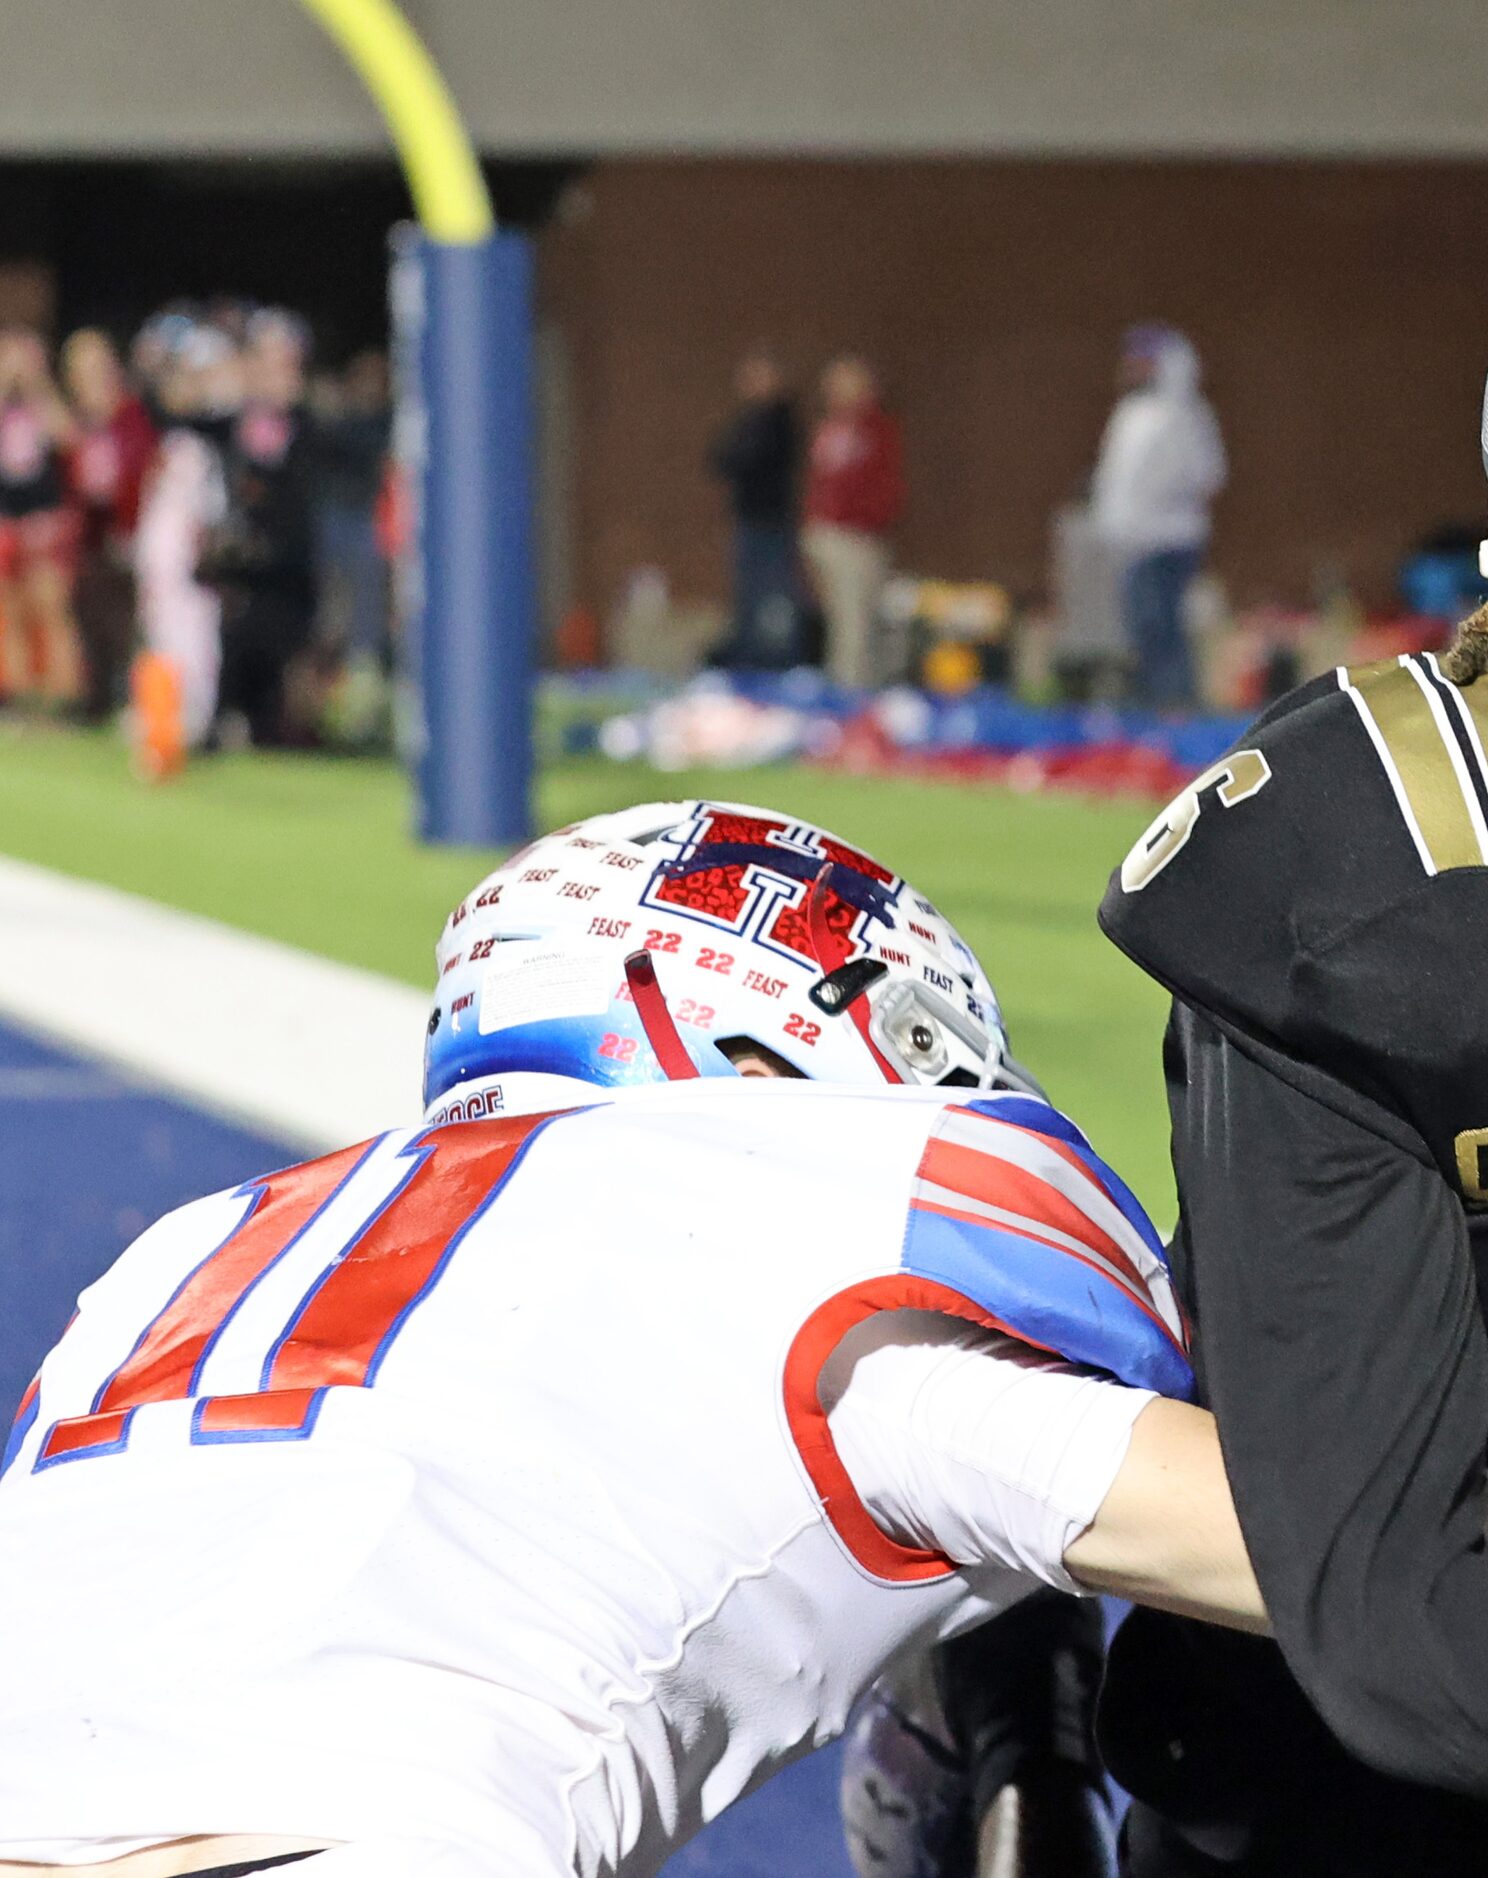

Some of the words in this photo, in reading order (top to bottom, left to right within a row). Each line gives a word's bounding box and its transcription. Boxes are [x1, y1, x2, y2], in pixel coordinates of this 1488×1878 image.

[1121, 749, 1272, 893] 6
[600, 851, 644, 872] FEAST
[518, 869, 559, 884] FEAST
[556, 882, 602, 901] FEAST
[587, 917, 632, 939] FEAST
[908, 920, 937, 945] HUNT
[469, 938, 496, 962] 22
[643, 929, 683, 953] 22
[695, 947, 736, 975] 22
[879, 945, 911, 967] HUNT
[742, 969, 789, 999] FEAST
[923, 965, 953, 994] FEAST
[451, 991, 476, 1014] HUNT
[675, 998, 716, 1029] 22
[782, 1012, 821, 1047] 22
[597, 1032, 638, 1063] 22
[31, 1102, 616, 1475] 11
